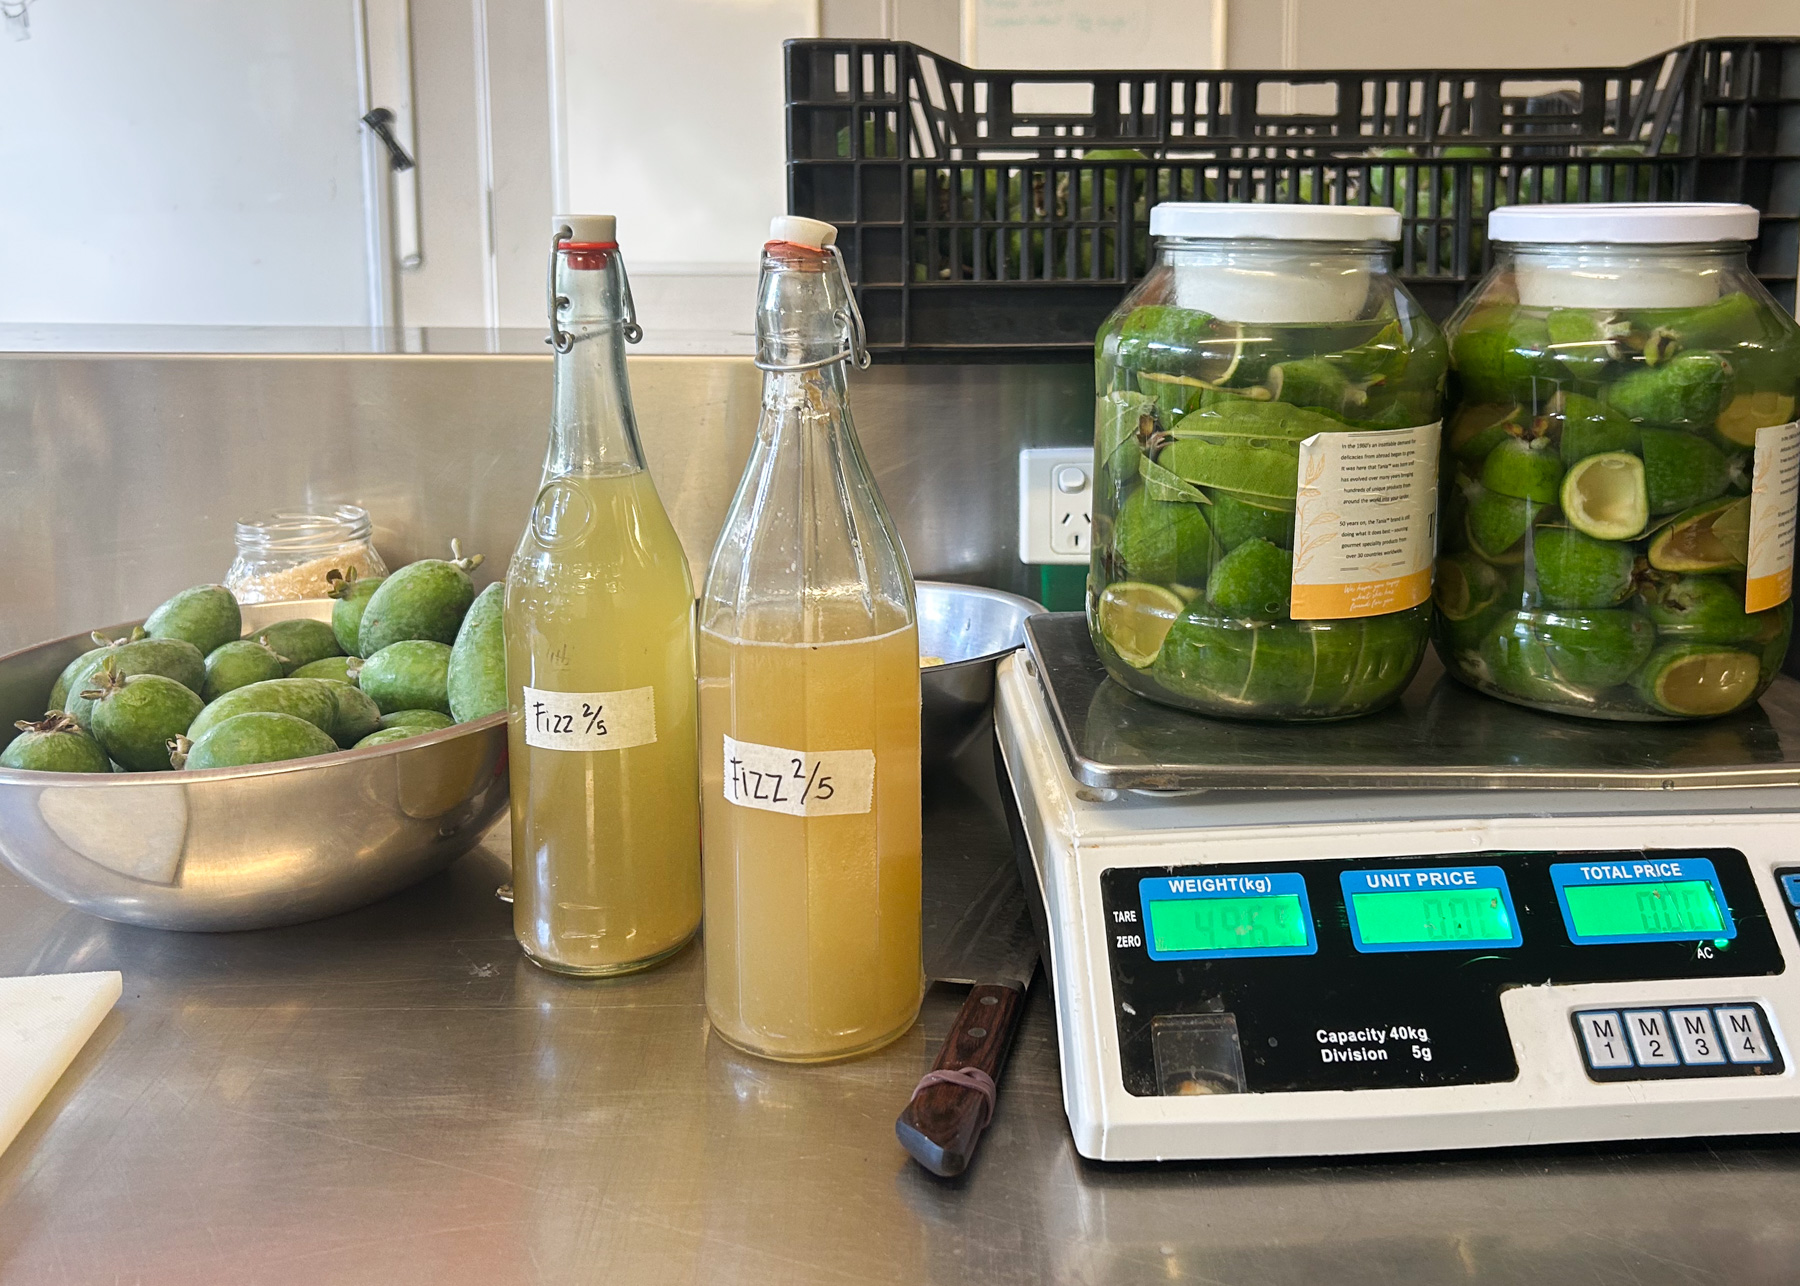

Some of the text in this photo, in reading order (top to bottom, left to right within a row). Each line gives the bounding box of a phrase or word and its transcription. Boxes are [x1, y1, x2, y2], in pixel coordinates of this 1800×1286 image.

[1382, 538, 1398, 546] products
[1344, 584, 1355, 594] We
[1365, 871, 1477, 889] UNIT PRICE
[1580, 863, 1683, 881] TOTAL PRICE
[1168, 876, 1272, 895] WEIGHT(kg)
[1113, 910, 1137, 923] TARE
[1116, 935, 1141, 949] ZERO
[1696, 947, 1714, 960] AC
[1592, 1020, 1615, 1038] M
[1638, 1018, 1660, 1036] M
[1684, 1016, 1706, 1034] M
[1729, 1015, 1752, 1033] M
[1316, 1026, 1429, 1046] Capacity 40kg
[1321, 1045, 1433, 1063] Division 5g
[1604, 1041, 1615, 1059] 1
[1649, 1040, 1664, 1057] 2
[1695, 1039, 1710, 1056] 3
[1742, 1037, 1756, 1054] 4
